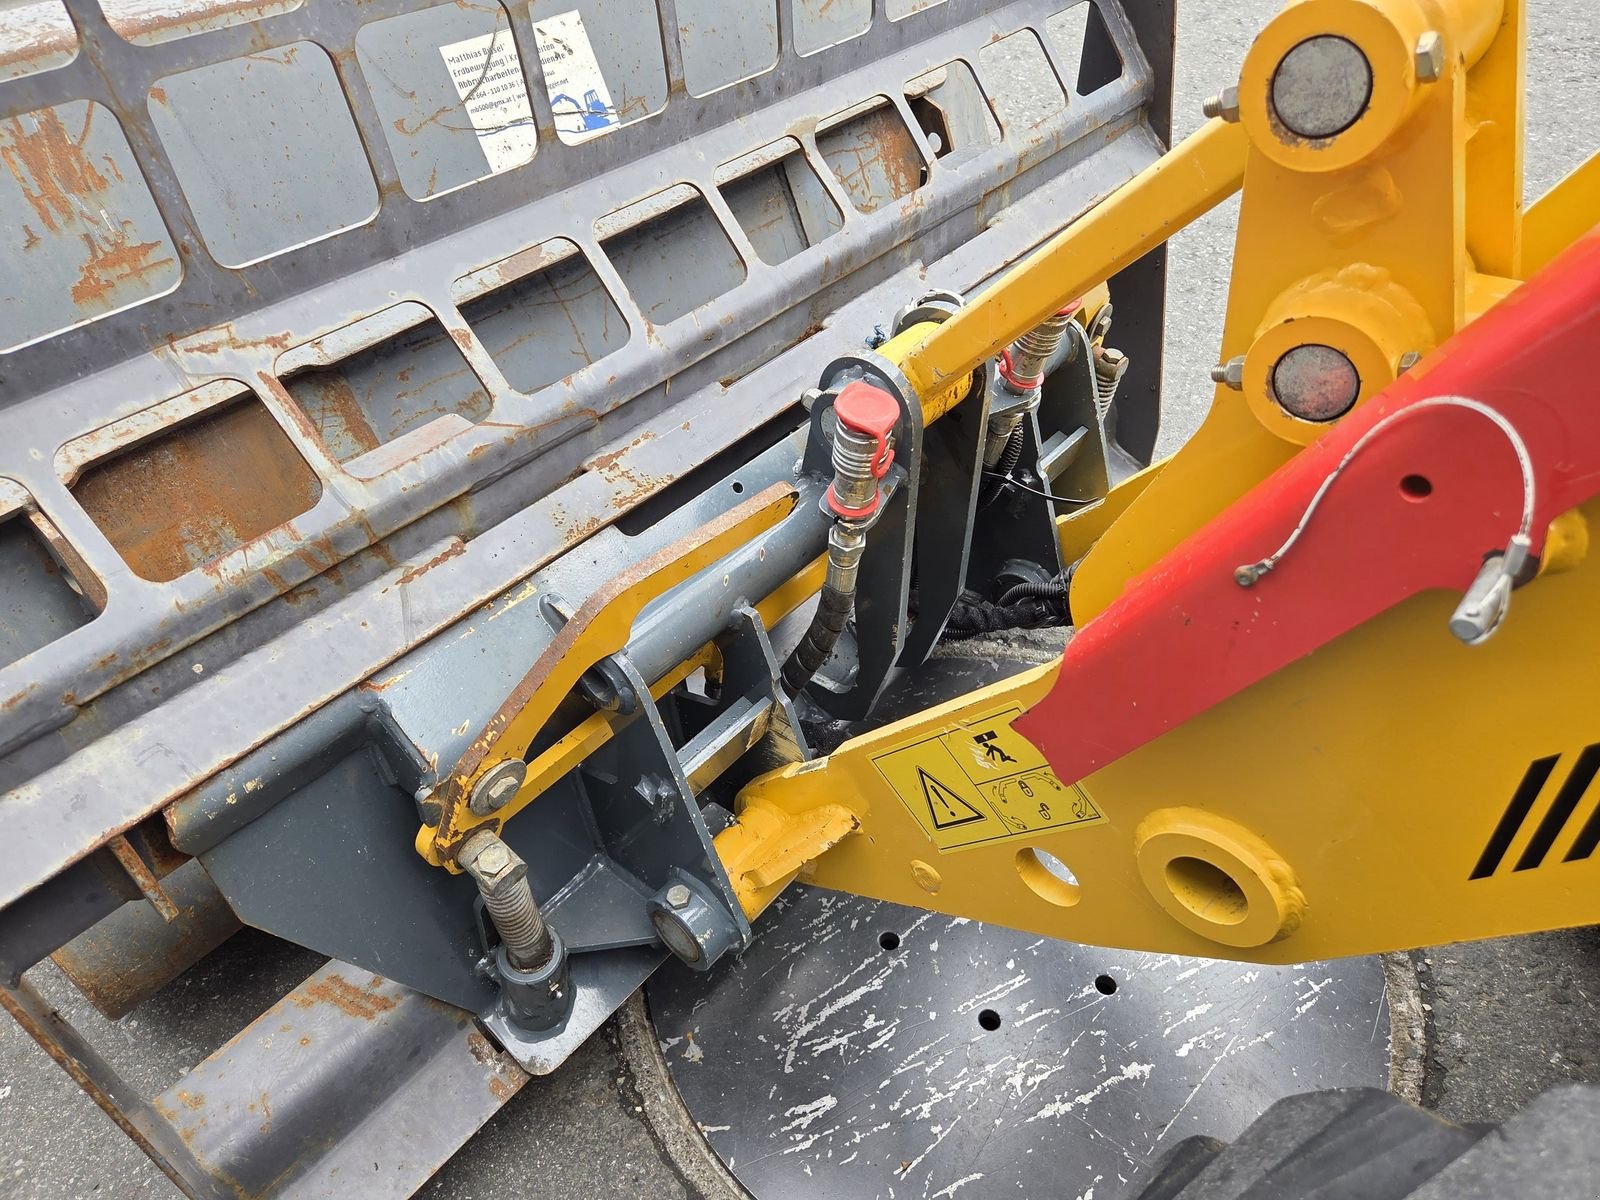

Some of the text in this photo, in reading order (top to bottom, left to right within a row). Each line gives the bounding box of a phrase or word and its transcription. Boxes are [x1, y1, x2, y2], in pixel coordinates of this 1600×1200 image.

[447, 50, 482, 65] Matthias
[453, 58, 505, 78] Erdbewegung
[538, 43, 555, 53] eiten
[541, 52, 566, 65] dienste
